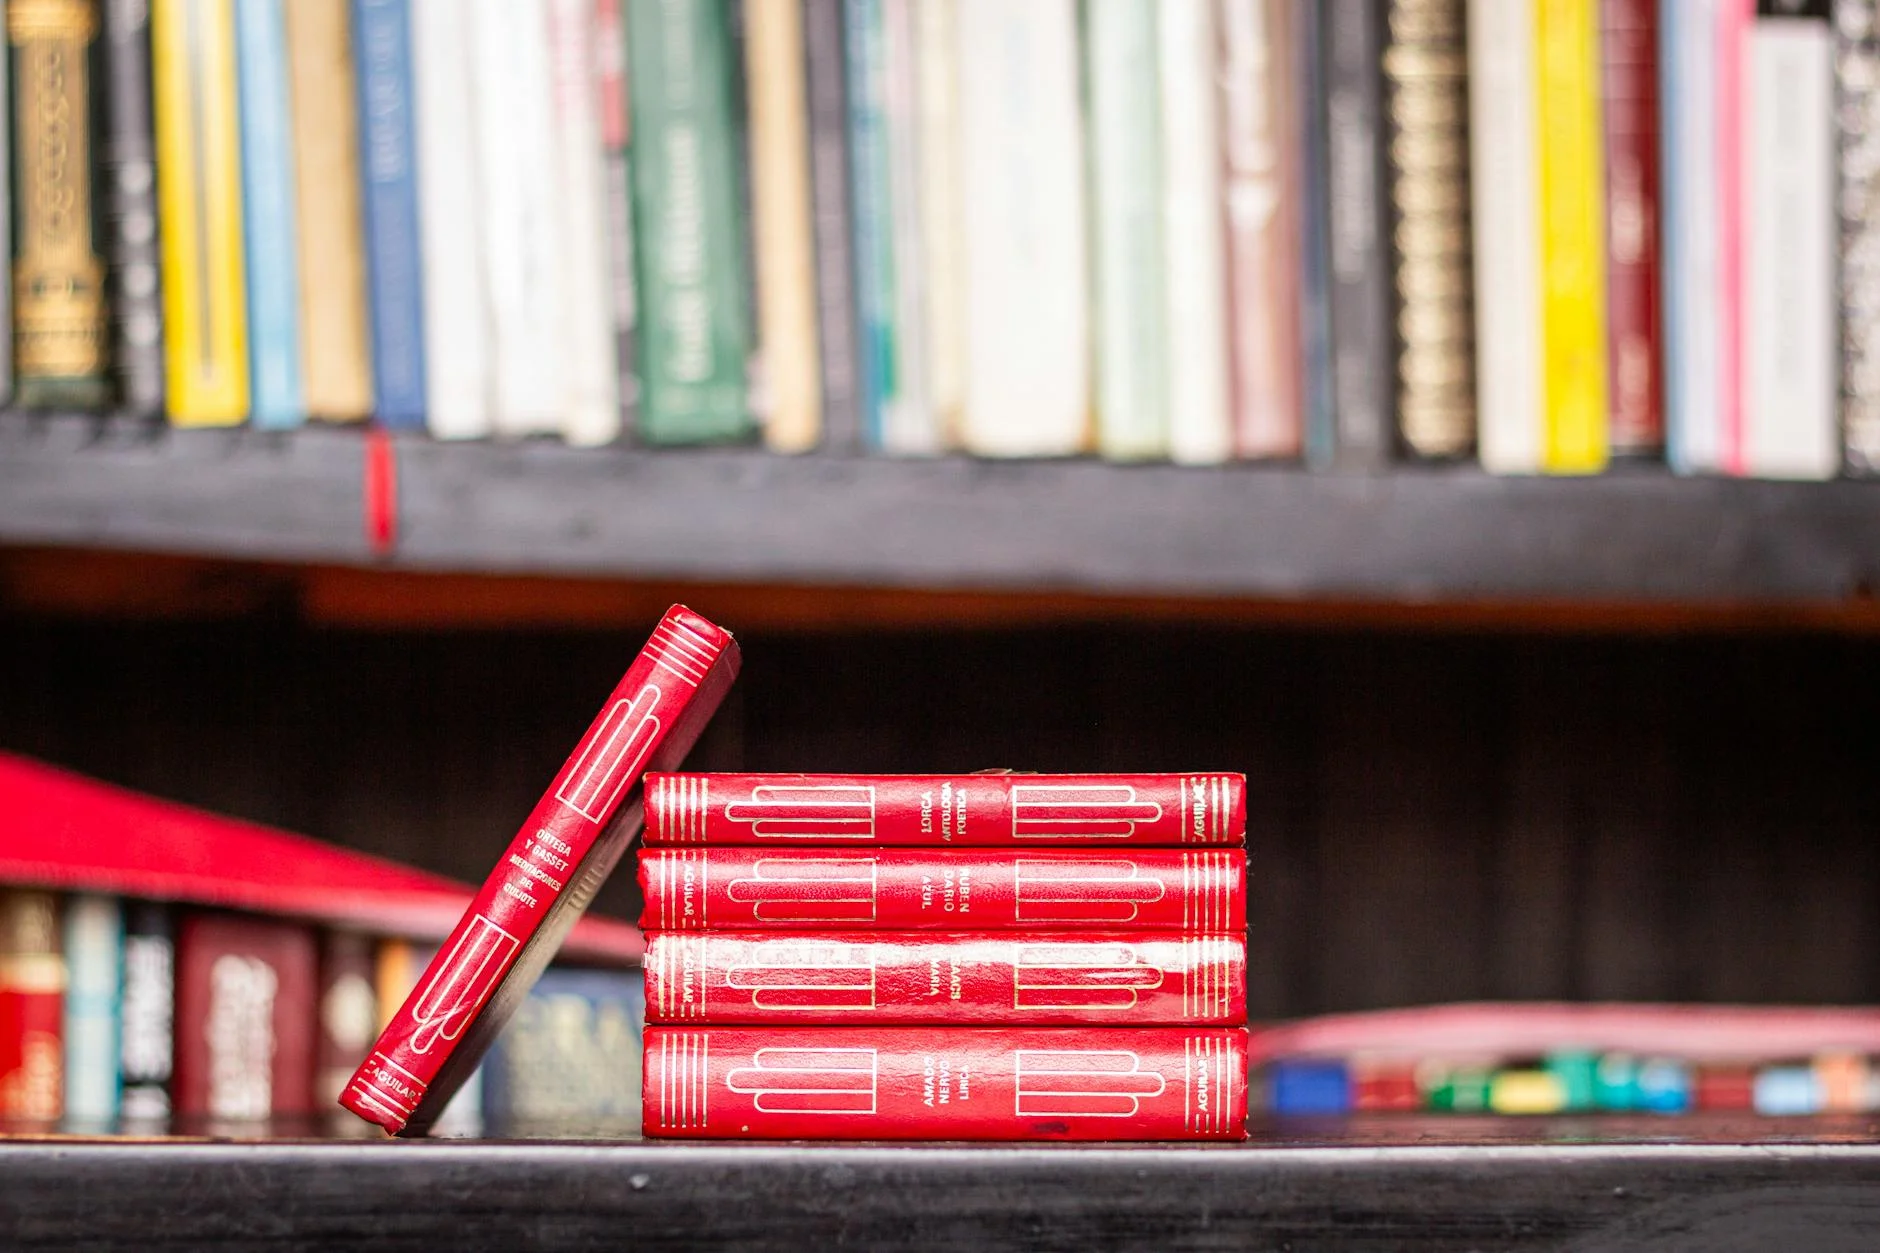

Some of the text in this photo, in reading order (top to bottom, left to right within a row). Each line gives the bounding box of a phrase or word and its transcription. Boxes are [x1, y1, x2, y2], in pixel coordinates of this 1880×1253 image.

[921, 791, 932, 833] LORCA
[942, 781, 952, 841] ANTOLOGIA
[956, 789, 967, 834] POETICA
[525, 839, 569, 872] Y GASSET
[536, 829, 571, 857] ORTEGA
[509, 853, 562, 891] MEDITACIONES
[519, 876, 534, 891] DEL
[684, 863, 695, 916] AGUILAR
[922, 876, 932, 910] AZUL
[943, 870, 955, 912] DARIO
[959, 868, 970, 913] RUBEN
[503, 882, 538, 909] QUIJOTE
[930, 958, 940, 996] MARIA
[950, 955, 961, 1000] SAACS
[371, 1067, 416, 1100] AGUILAR
[924, 1055, 935, 1107] AMADO
[939, 1059, 950, 1104] NERVO
[959, 1065, 969, 1100] LIRICA
[1197, 1059, 1208, 1112] AGUILAR
